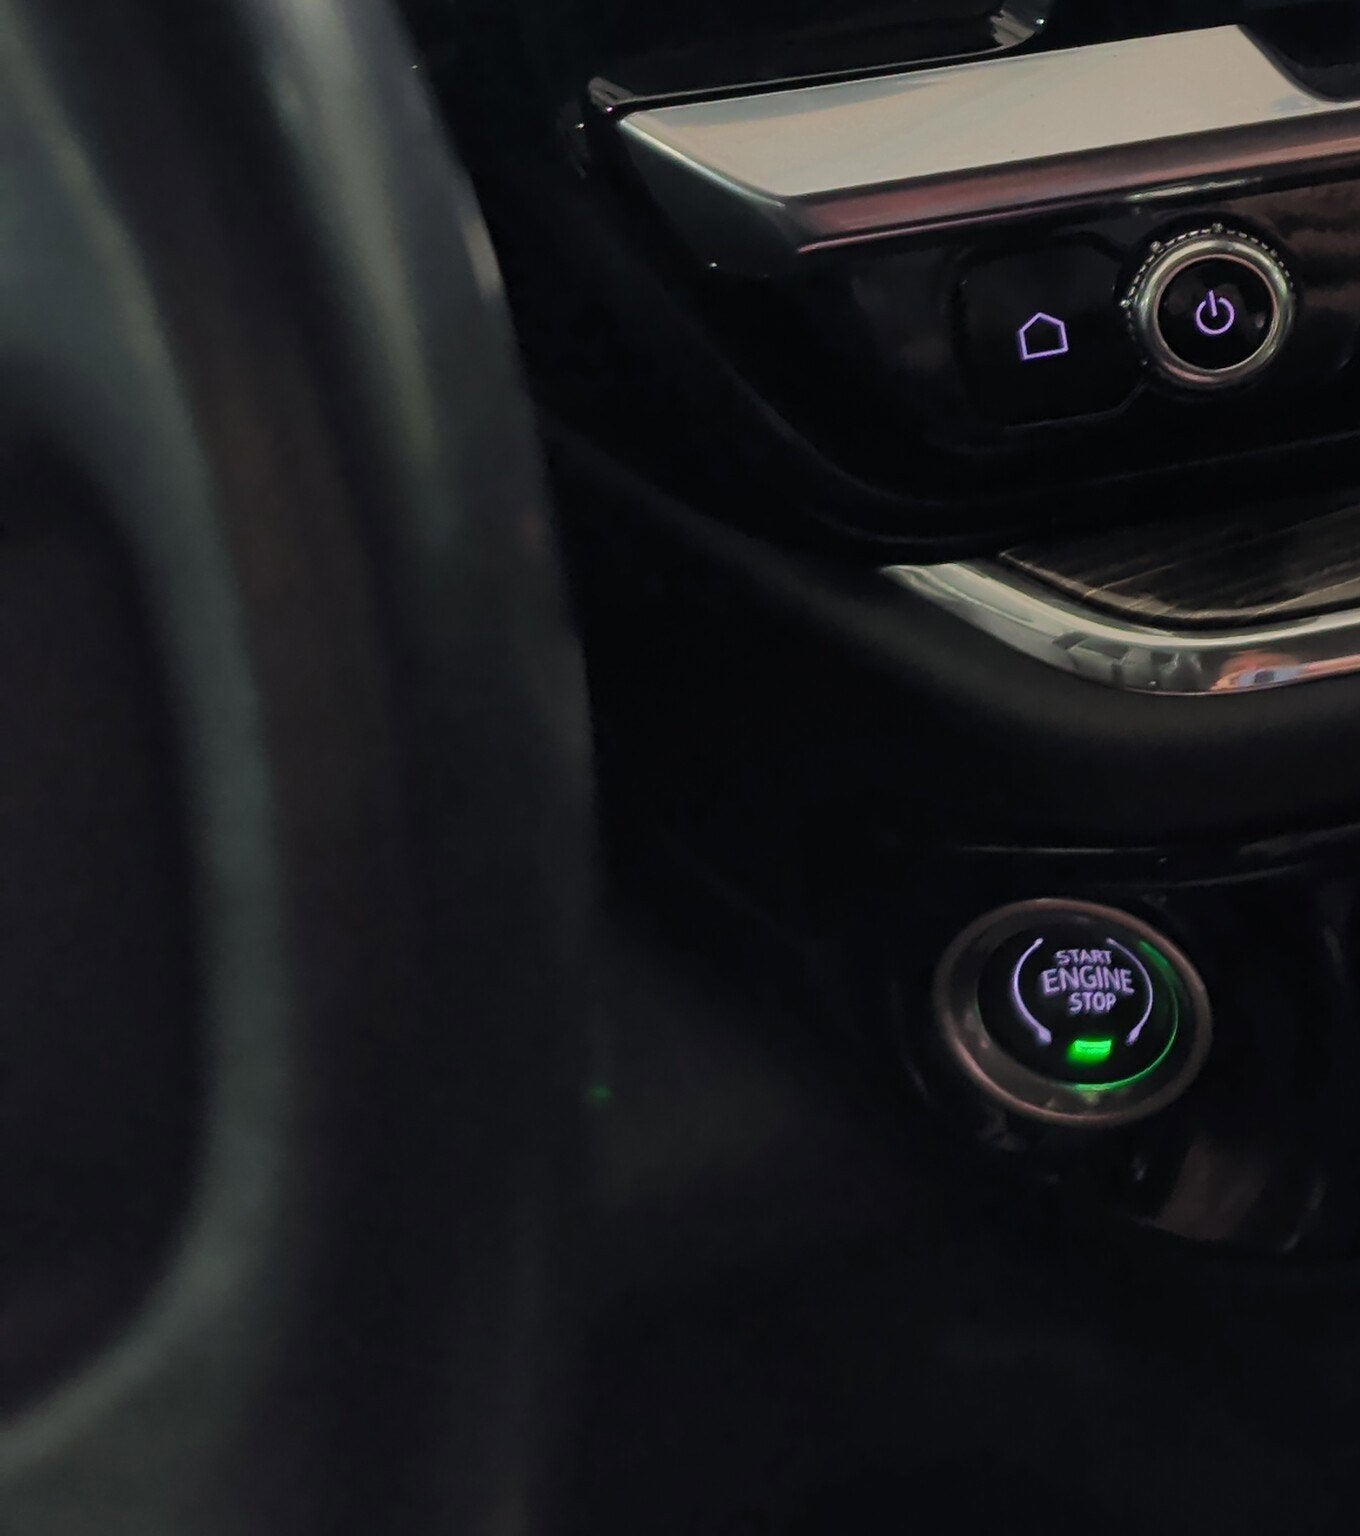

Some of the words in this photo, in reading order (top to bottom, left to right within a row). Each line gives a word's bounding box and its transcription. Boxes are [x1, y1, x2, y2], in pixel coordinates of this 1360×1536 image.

[1056, 950, 1111, 964] START
[1042, 966, 1134, 995] ENGINE
[1070, 993, 1116, 1012] STOP
